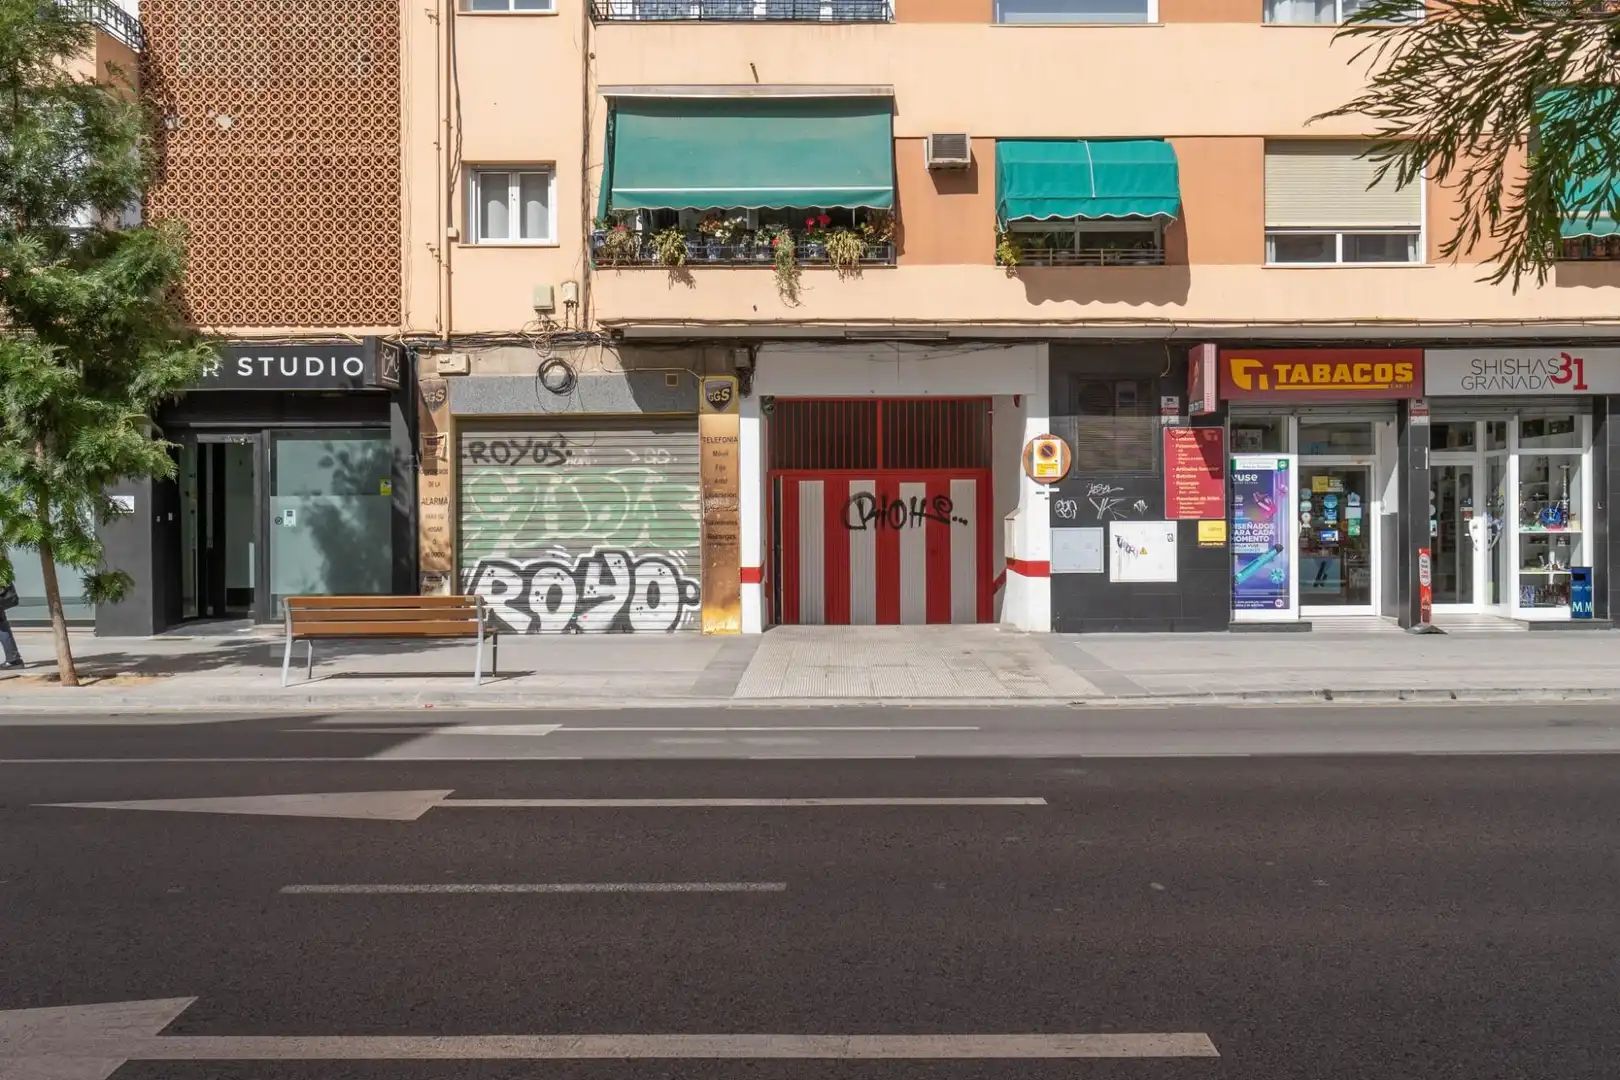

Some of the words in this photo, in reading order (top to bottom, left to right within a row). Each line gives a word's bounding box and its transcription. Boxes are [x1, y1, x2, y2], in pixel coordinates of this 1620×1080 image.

[237, 356, 364, 377] STUDIO
[1273, 362, 1413, 383] TABACOS
[1471, 358, 1560, 375] SHISHAS
[1550, 352, 1588, 390] 31
[1461, 375, 1555, 390] GRANADA
[708, 386, 731, 403] GGS
[421, 497, 448, 505] ALARMA
